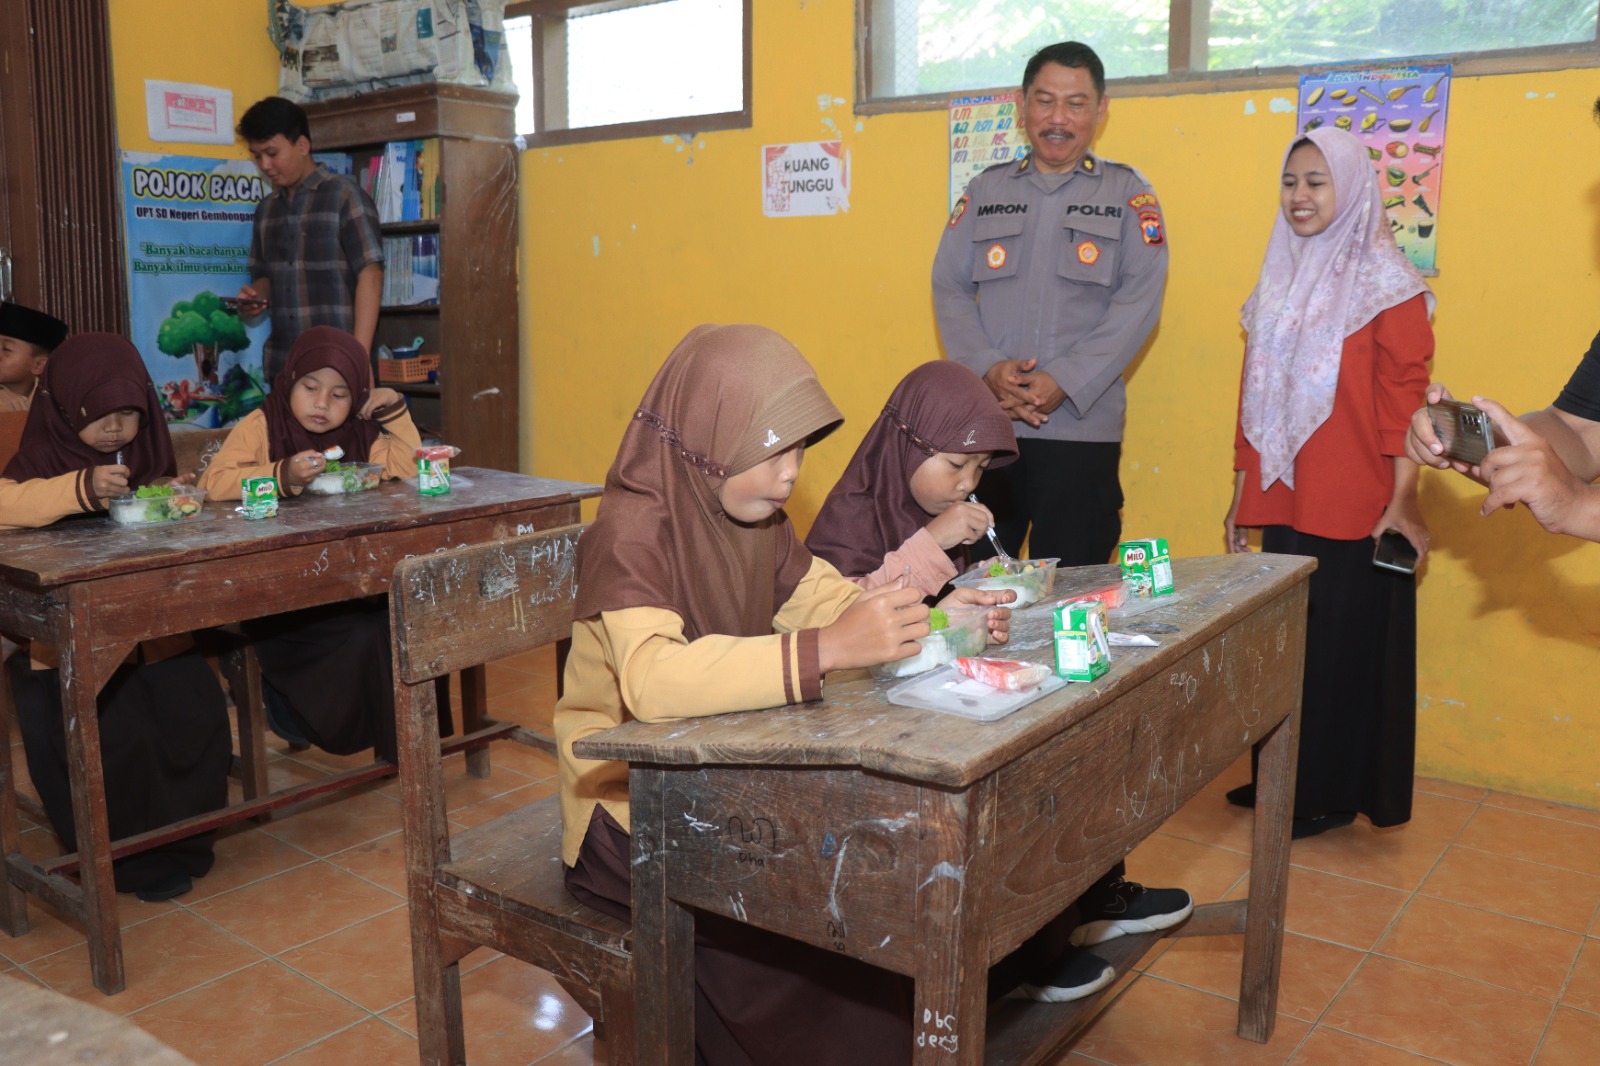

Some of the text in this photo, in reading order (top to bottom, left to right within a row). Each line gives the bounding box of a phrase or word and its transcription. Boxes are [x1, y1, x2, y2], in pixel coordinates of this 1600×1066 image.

[134, 168, 264, 202] POJOK BACA
[780, 178, 834, 193] TUNGGU
[136, 206, 153, 218] UPT
[156, 208, 168, 219] SD
[170, 209, 199, 222] Negeri
[977, 203, 1122, 218] IMRON POLRI
[189, 245, 212, 256] baca
[213, 246, 249, 259] banyak
[134, 260, 173, 276] Banyak
[176, 261, 200, 273] ilmu
[202, 261, 243, 274] semakin
[1126, 552, 1144, 562] MILO
